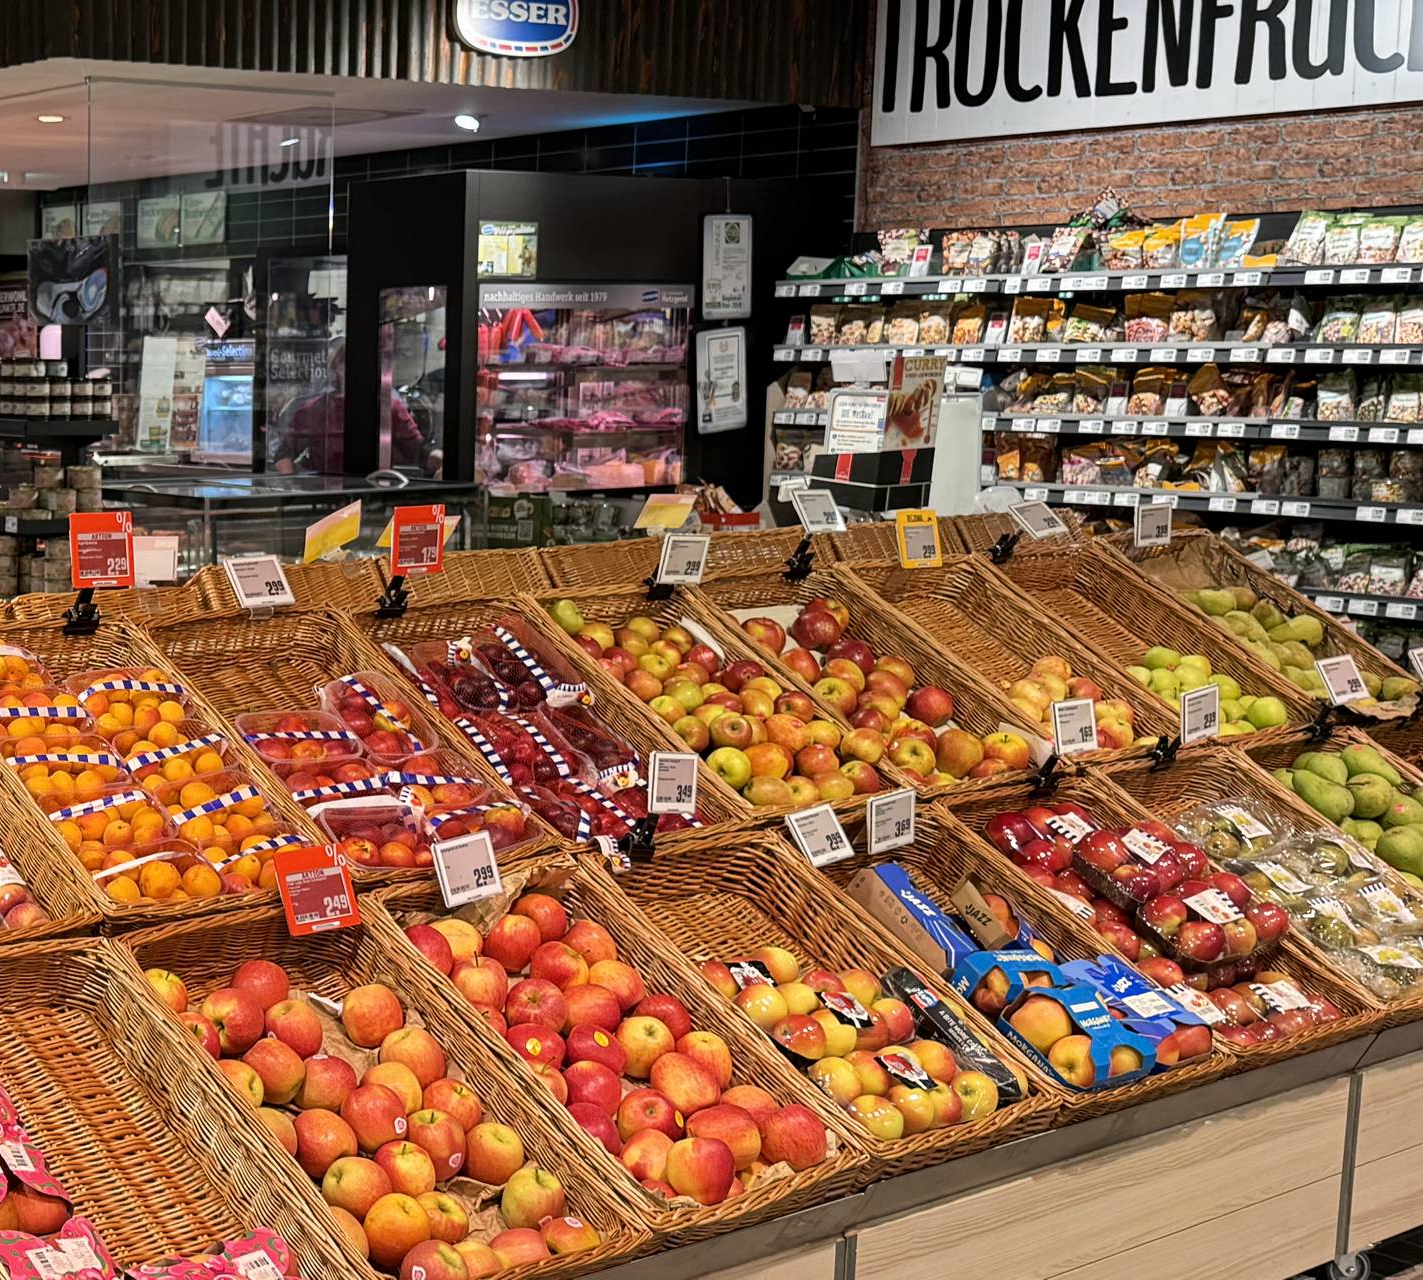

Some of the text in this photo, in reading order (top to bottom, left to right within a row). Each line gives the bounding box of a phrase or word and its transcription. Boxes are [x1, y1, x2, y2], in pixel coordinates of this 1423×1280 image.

[470, 0, 567, 25] ESSER
[483, 290, 607, 303] nachhaltiges Handwerk seit 1979
[270, 349, 327, 364] Gourmet
[905, 358, 945, 371] CURRY
[107, 557, 127, 576] 2.29
[265, 580, 285, 596] 2.99
[676, 784, 693, 803] 3.49
[894, 818, 911, 838] 3.69
[473, 865, 494, 888] 2.99
[323, 894, 348, 917] 2.49
[965, 903, 992, 927] JAZZ
